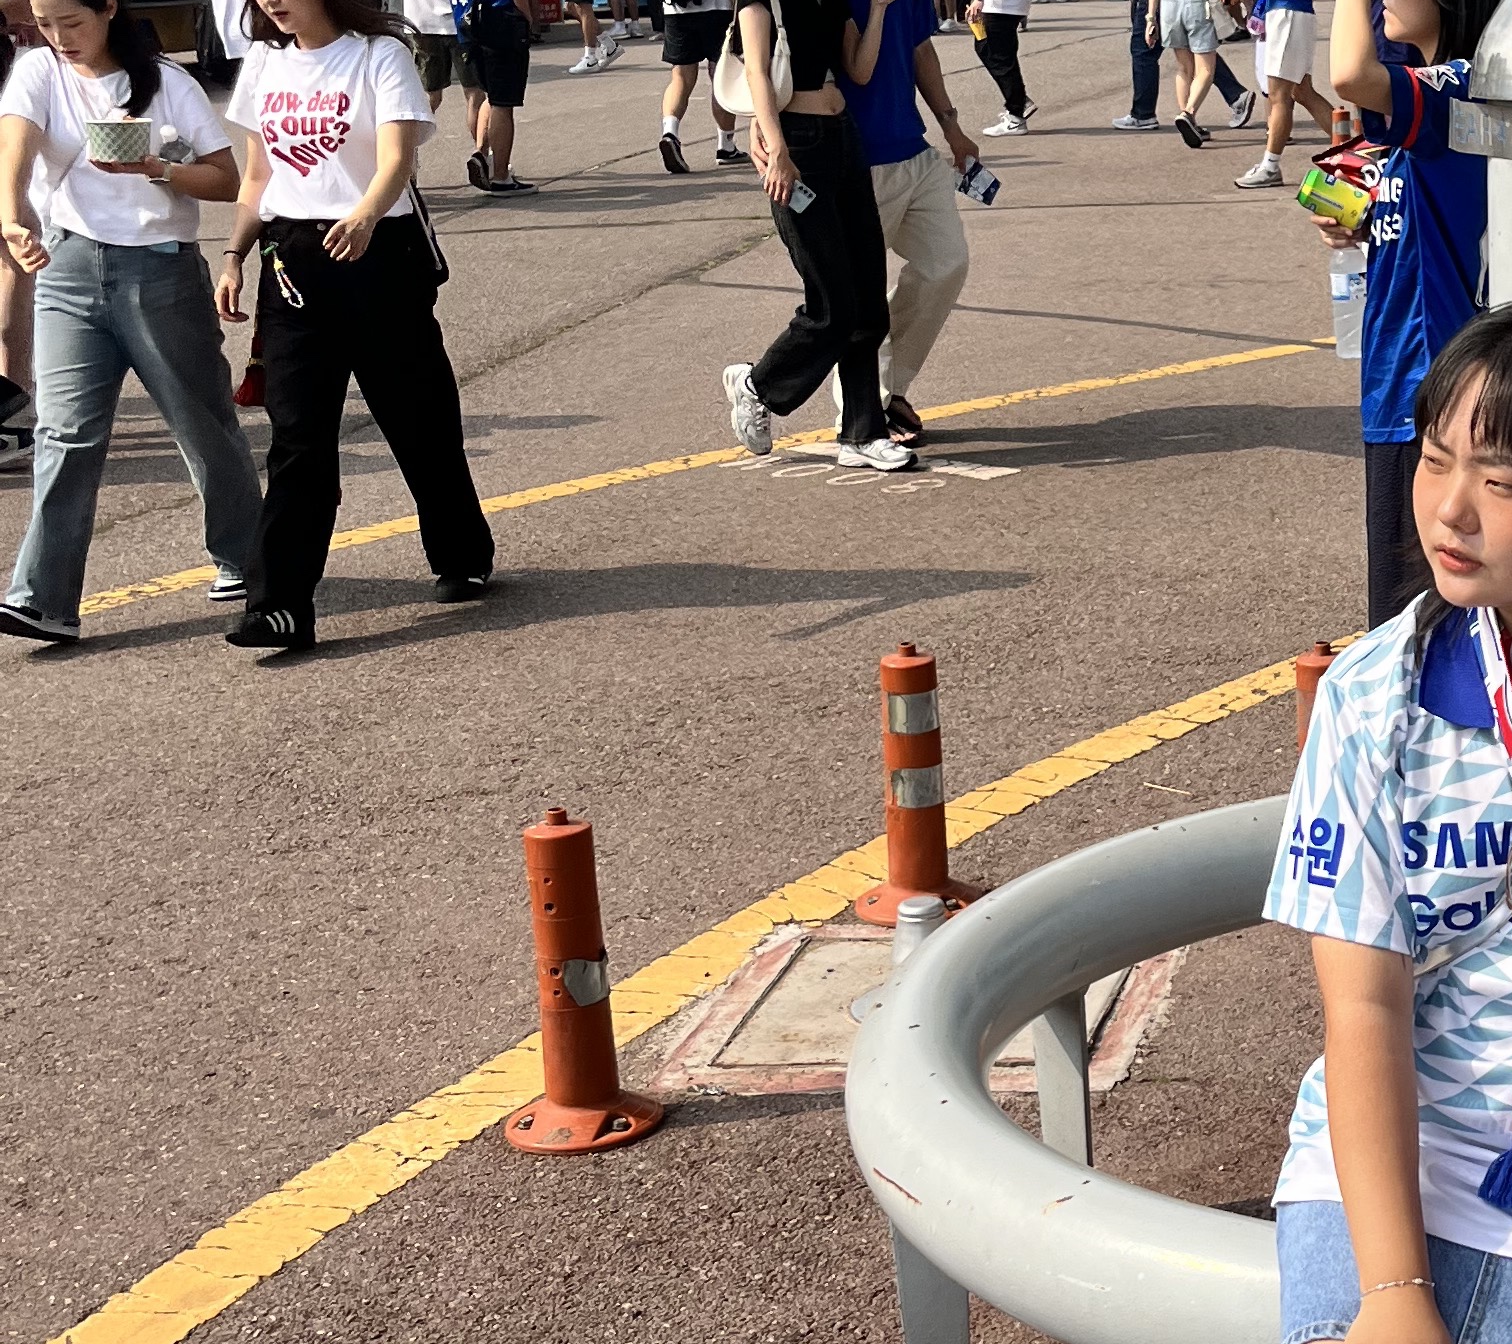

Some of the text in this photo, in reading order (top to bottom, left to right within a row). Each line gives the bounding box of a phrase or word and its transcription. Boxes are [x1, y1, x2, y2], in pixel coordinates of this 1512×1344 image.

[307, 89, 351, 117] deep
[281, 115, 336, 136] our
[1289, 814, 1345, 888] 수원
